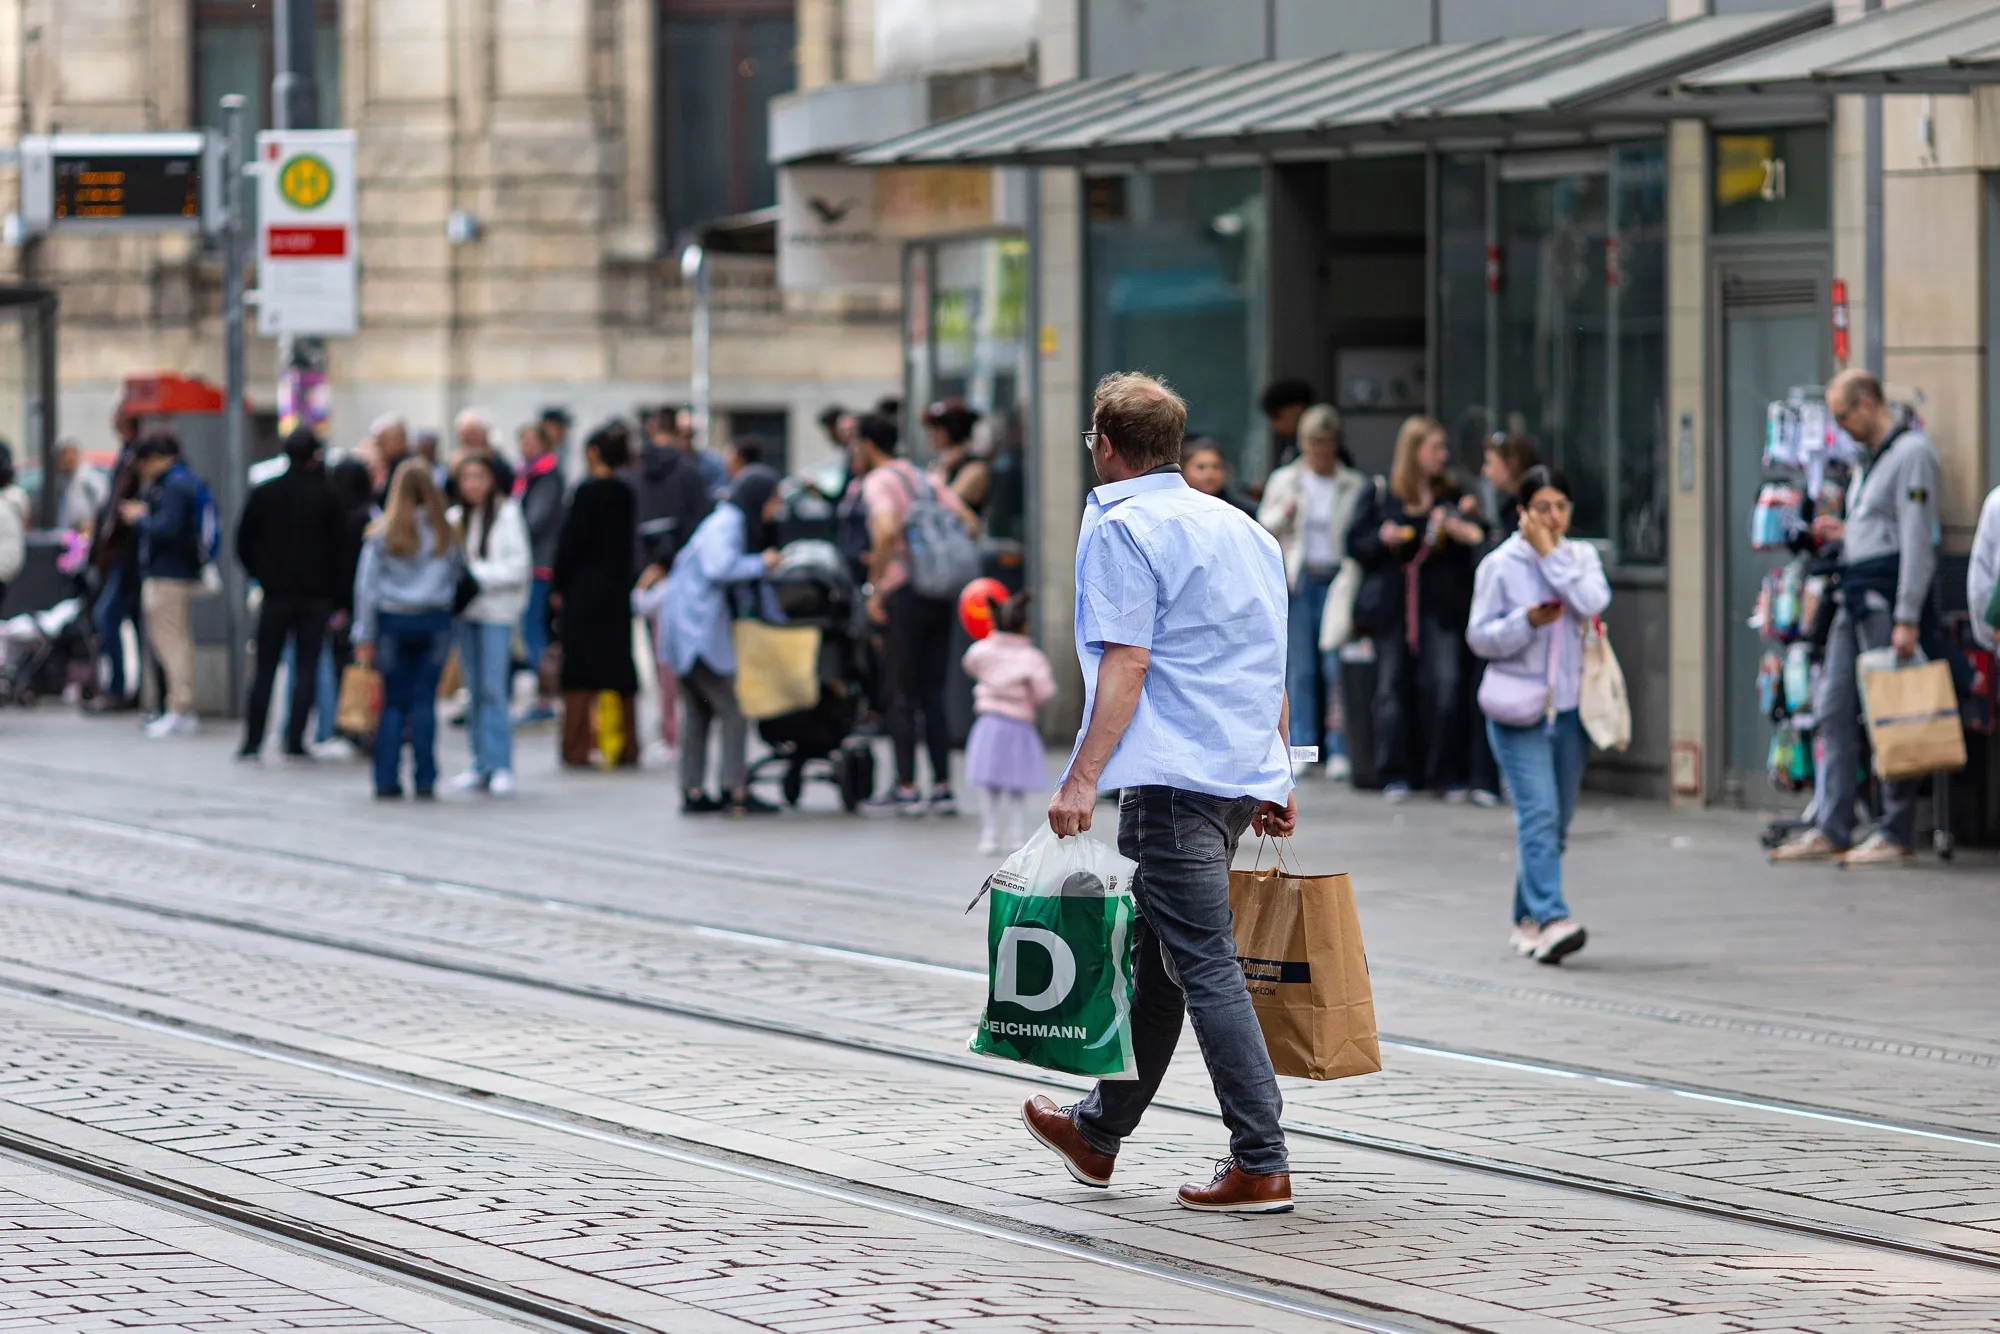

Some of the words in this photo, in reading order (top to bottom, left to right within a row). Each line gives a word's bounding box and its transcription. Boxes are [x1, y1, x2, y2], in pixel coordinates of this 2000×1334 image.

[1760, 158, 1786, 200] 21
[994, 926, 1076, 1012] D
[1242, 959, 1282, 981] Cloppenburg
[1246, 985, 1276, 996] AAF.COM
